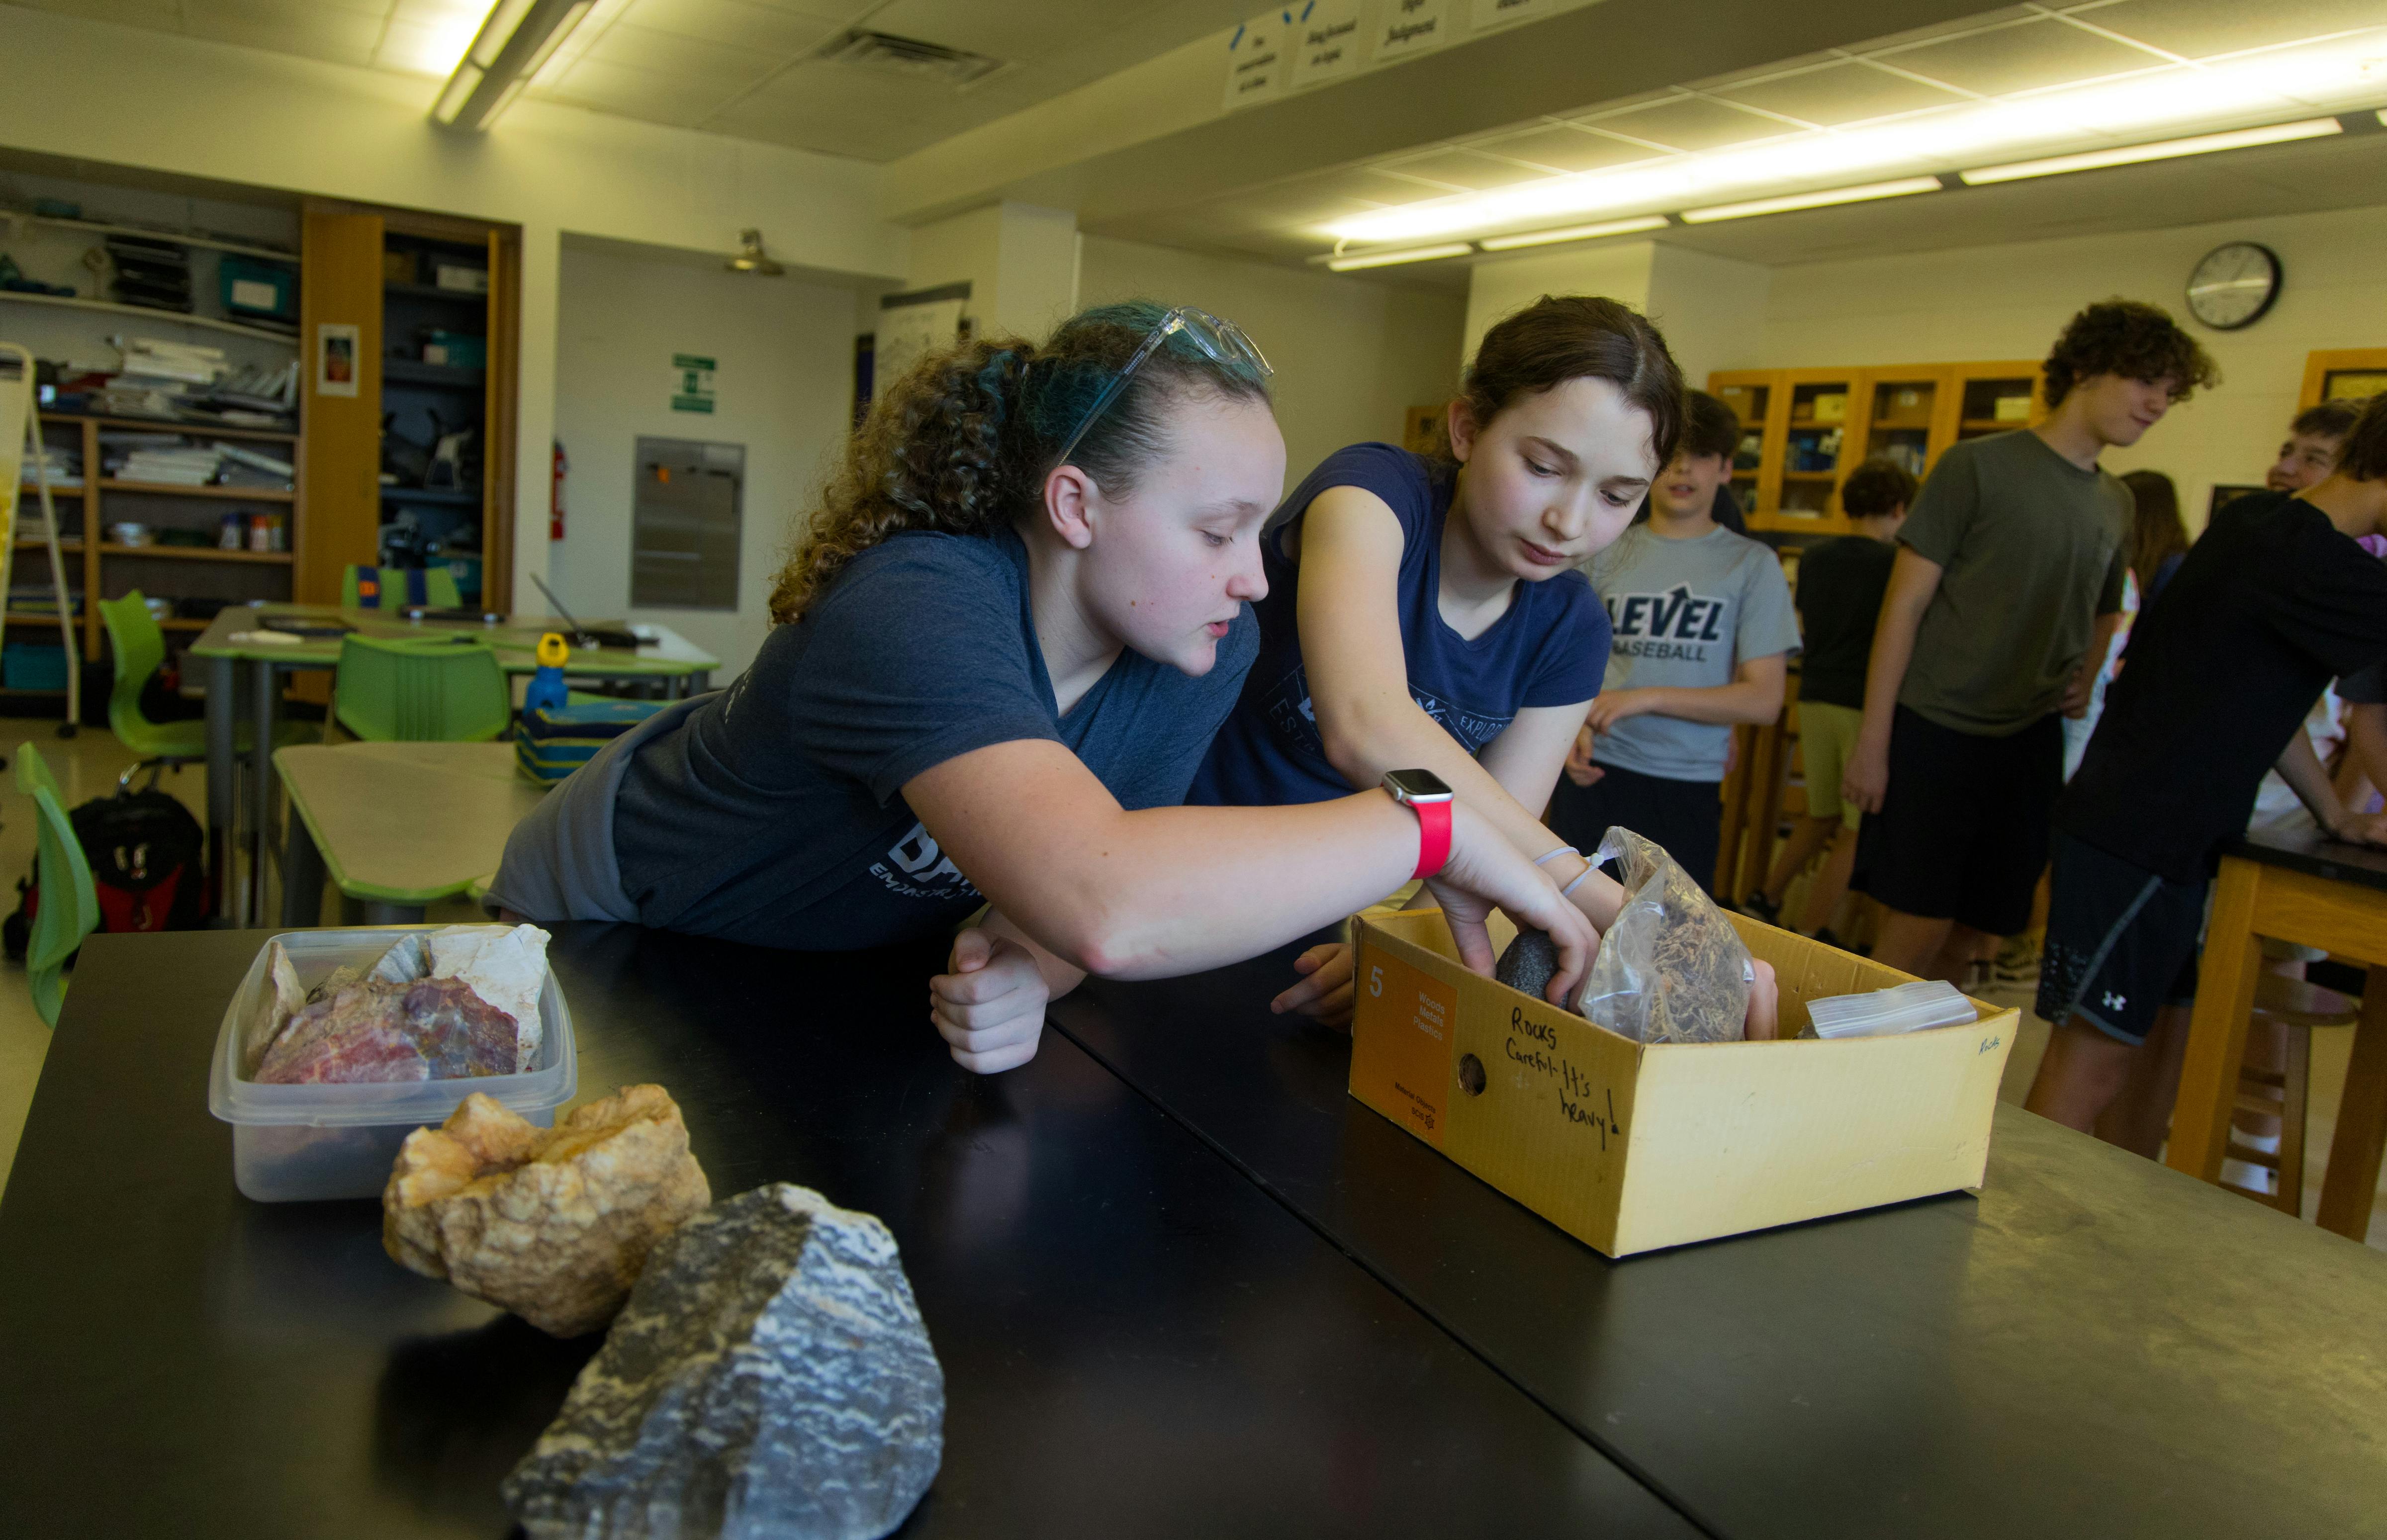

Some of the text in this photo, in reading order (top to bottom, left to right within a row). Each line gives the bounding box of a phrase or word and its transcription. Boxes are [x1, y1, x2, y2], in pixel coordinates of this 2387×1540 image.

[1369, 966, 1383, 997] 5
[1419, 991, 1445, 1015] Woods
[1419, 1004, 1444, 1027] Metals
[1413, 1015, 1443, 1041] Plastics
[1394, 1081, 1436, 1114] Material Objects
[1412, 1106, 1424, 1121] SCIS
